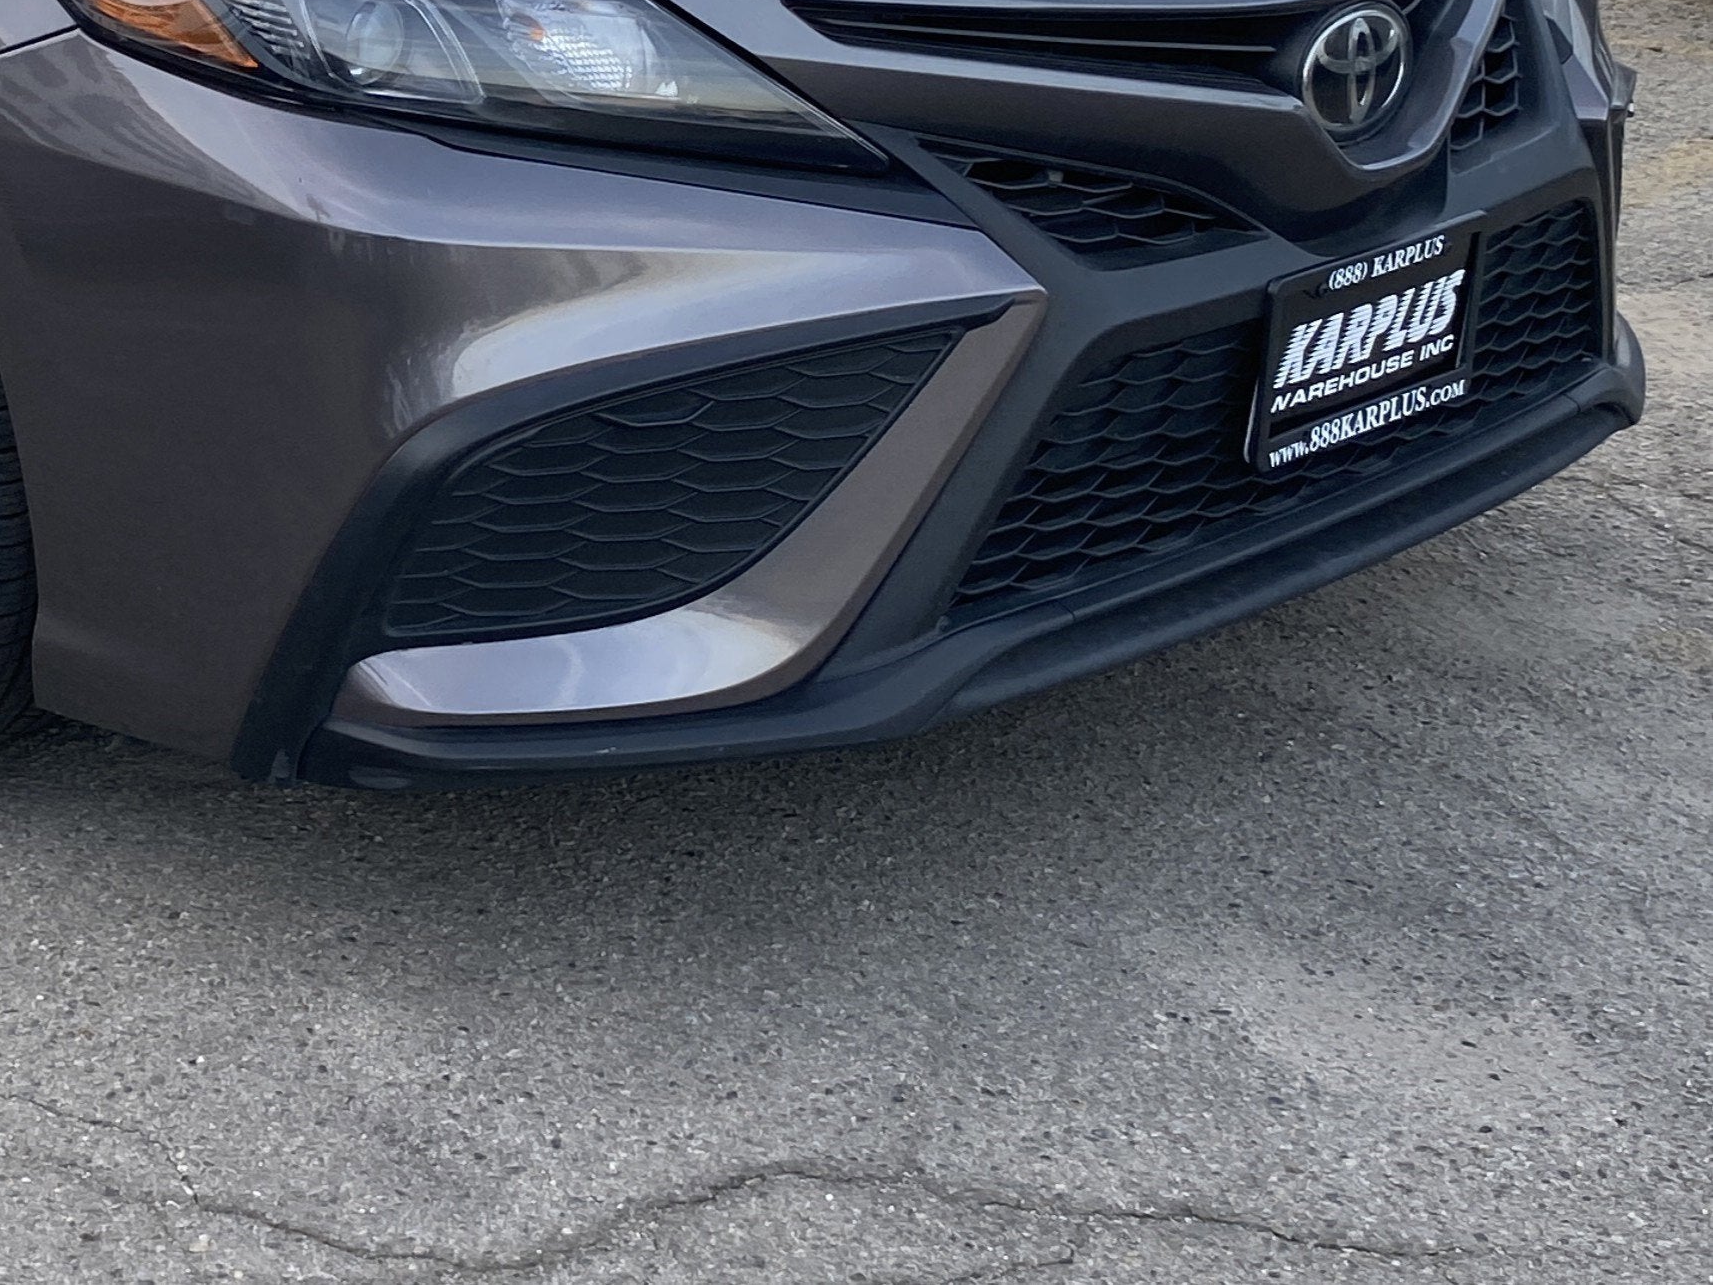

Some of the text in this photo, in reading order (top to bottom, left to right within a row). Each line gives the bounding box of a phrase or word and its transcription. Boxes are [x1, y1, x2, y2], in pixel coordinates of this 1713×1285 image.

[1328, 234, 1445, 291] (888) KARPLUS
[1272, 269, 1466, 389] KARPLUS
[1270, 334, 1454, 413] WAREHOUSE INC
